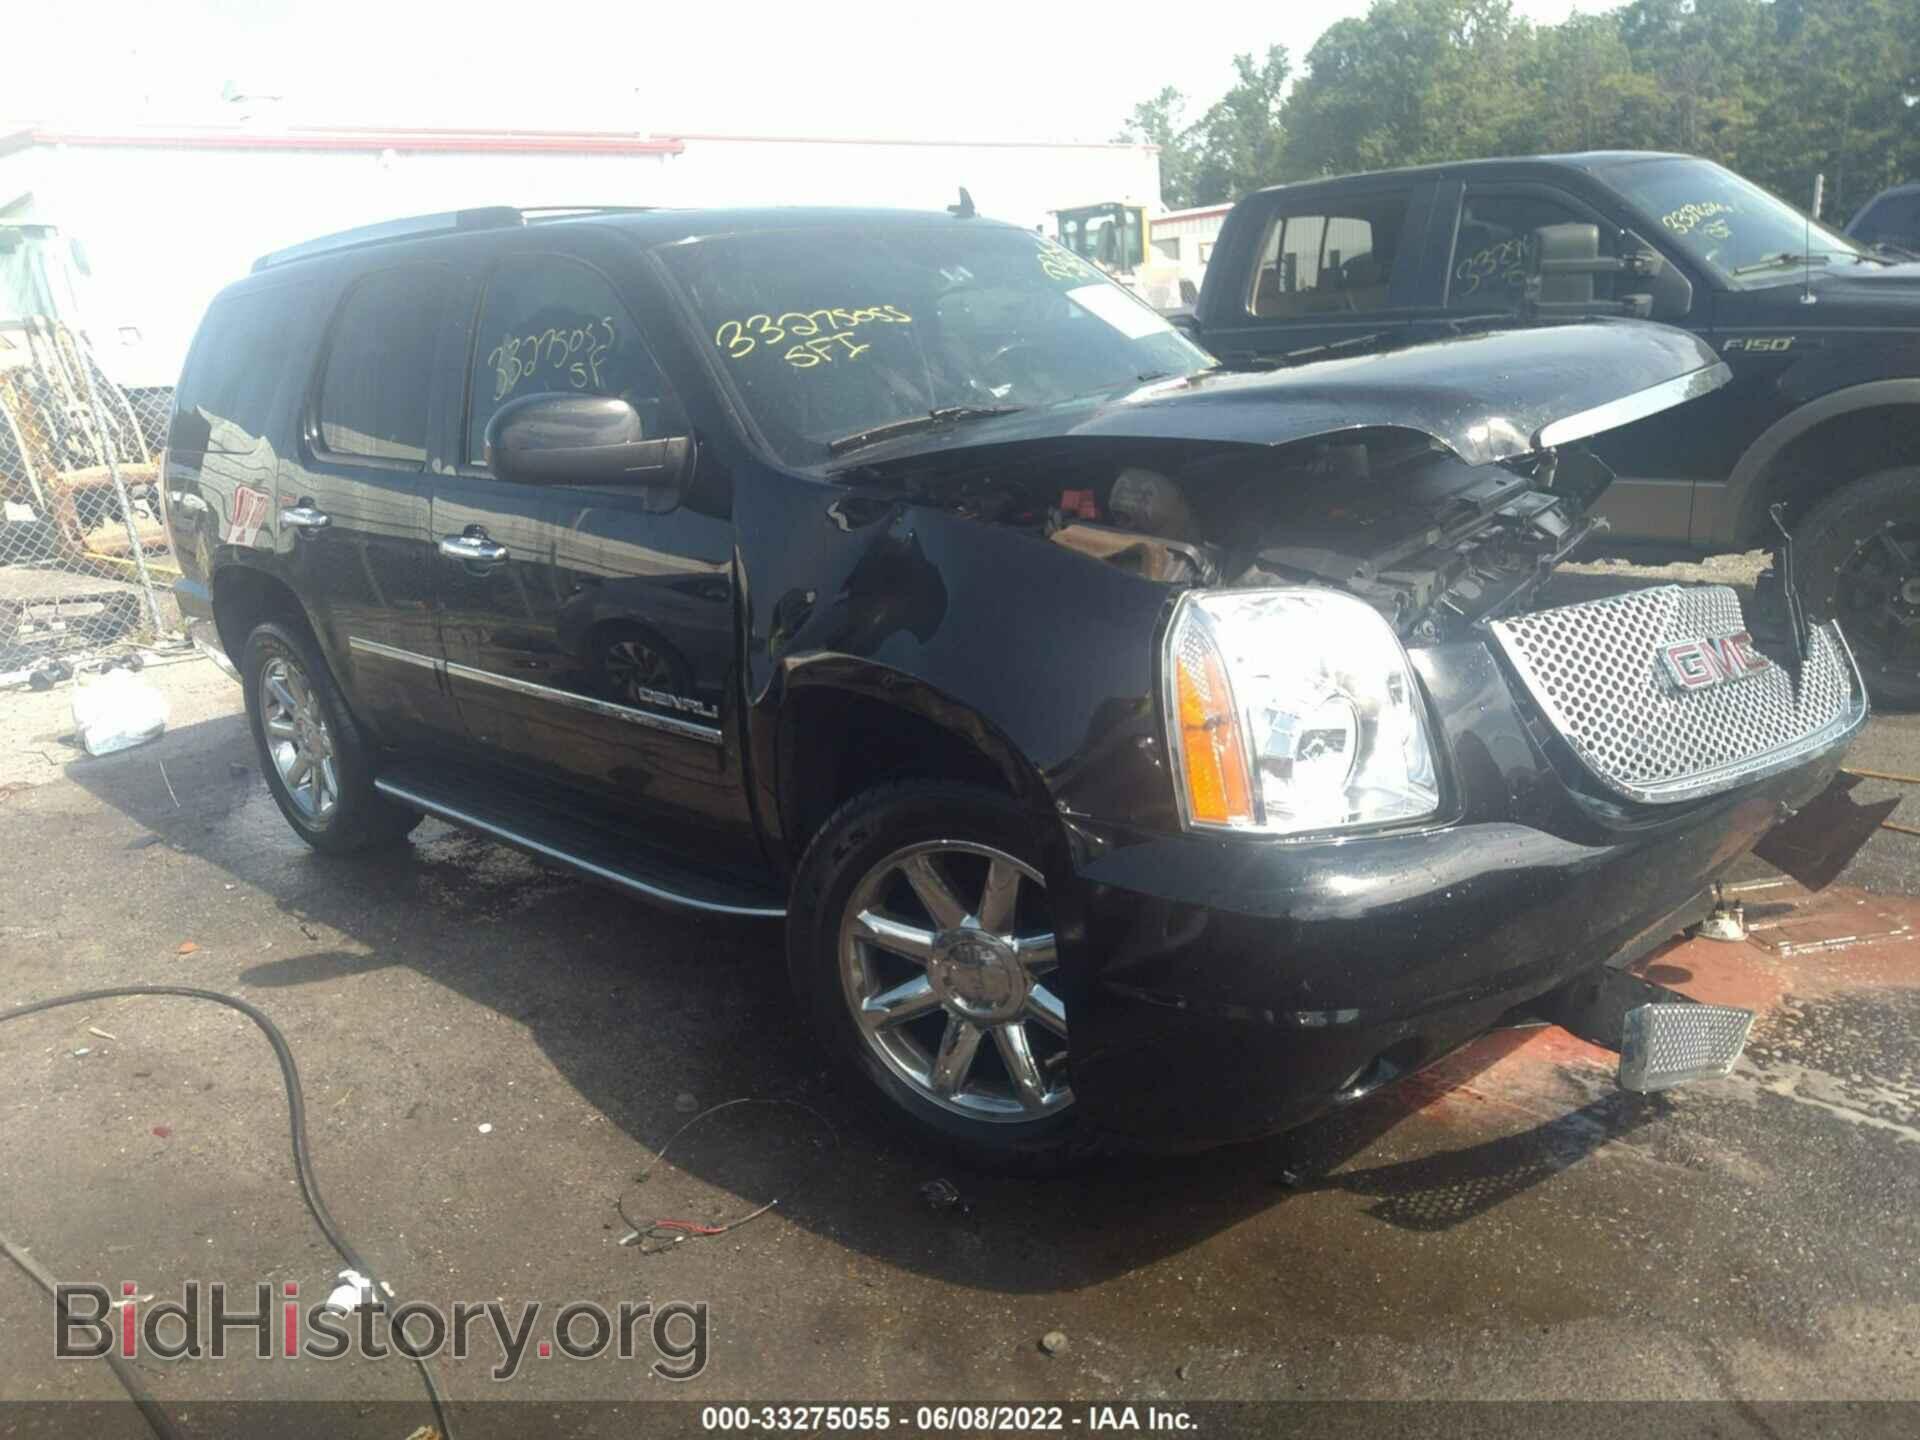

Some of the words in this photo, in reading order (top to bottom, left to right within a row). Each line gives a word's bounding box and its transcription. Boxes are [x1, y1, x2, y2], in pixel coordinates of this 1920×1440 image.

[716, 305, 912, 358] 33275055
[1722, 337, 1794, 352] F-150
[1665, 632, 1772, 687] GMC
[638, 687, 719, 719] DENALI
